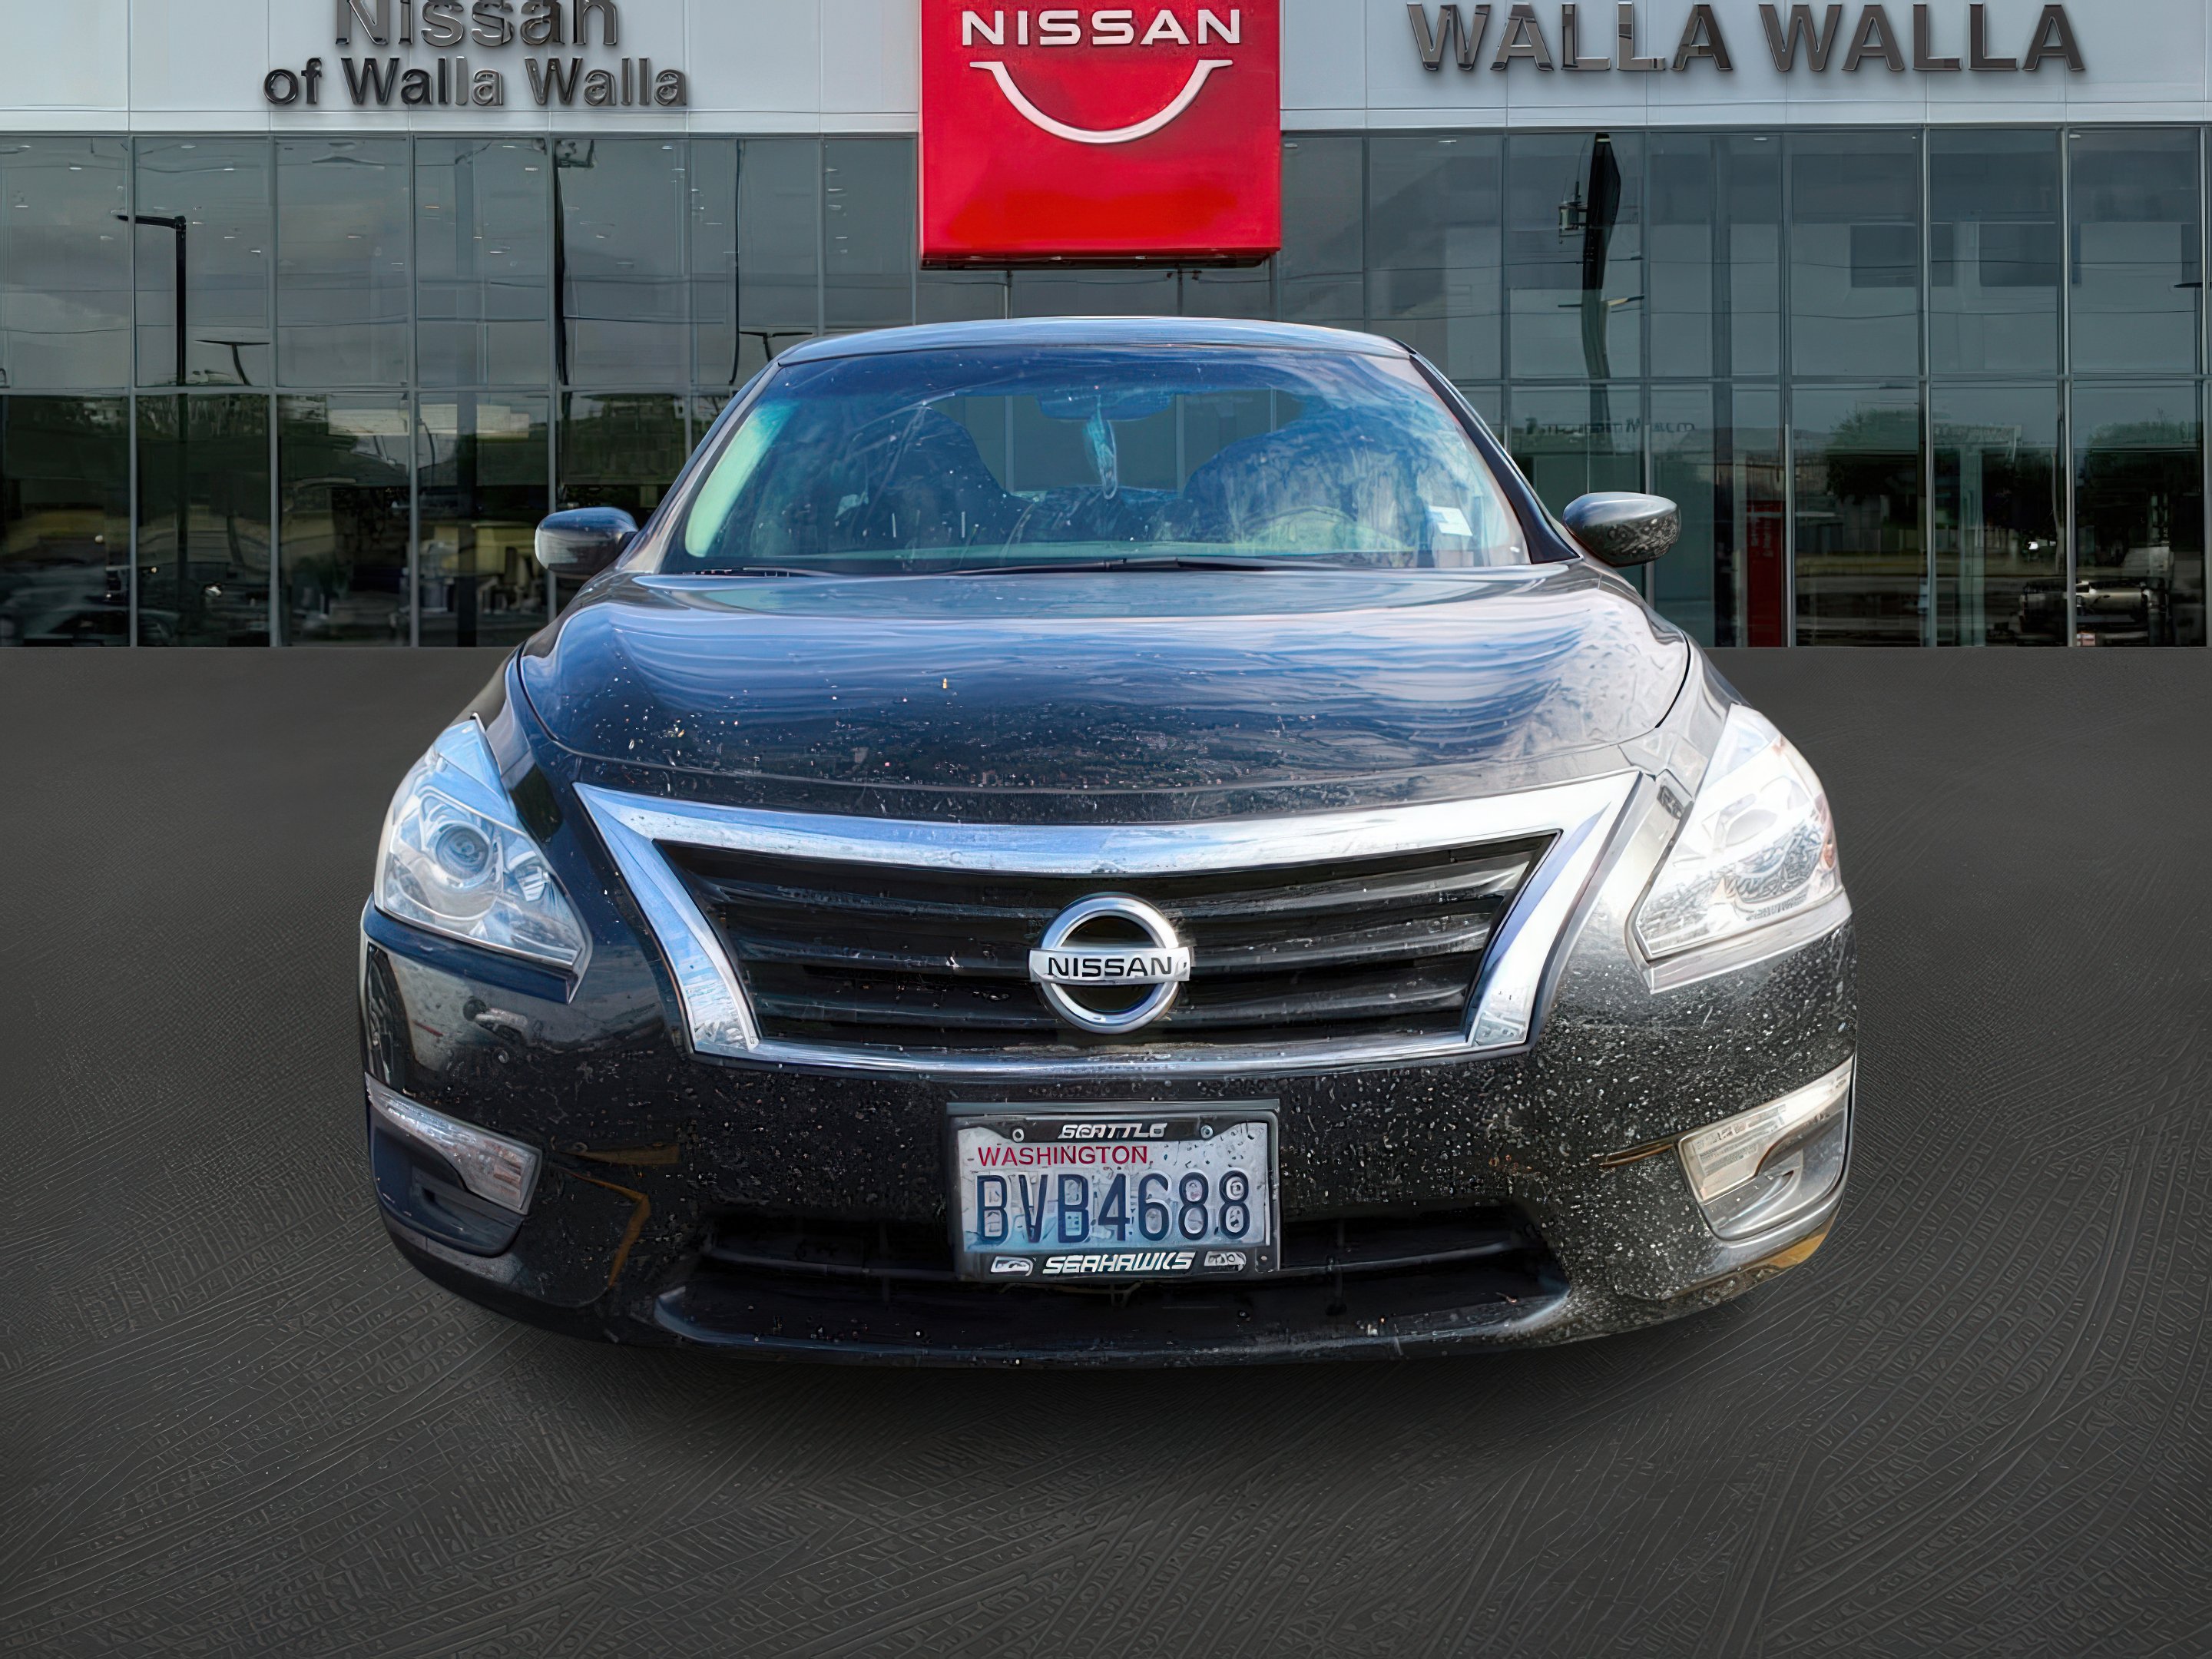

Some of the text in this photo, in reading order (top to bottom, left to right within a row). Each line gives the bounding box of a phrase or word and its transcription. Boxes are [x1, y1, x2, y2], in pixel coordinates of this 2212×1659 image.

[335, 0, 618, 46] Nissan
[962, 9, 1240, 45] NISSAN
[1407, 4, 2085, 71] WALLA WALLA
[263, 56, 687, 106] of Walla Walla
[1048, 956, 1172, 978] NISSAN
[978, 1145, 1147, 1166] WASHINGTON
[976, 1170, 1250, 1244] BVB4688
[1042, 1252, 1197, 1274] SEAHAWKS
